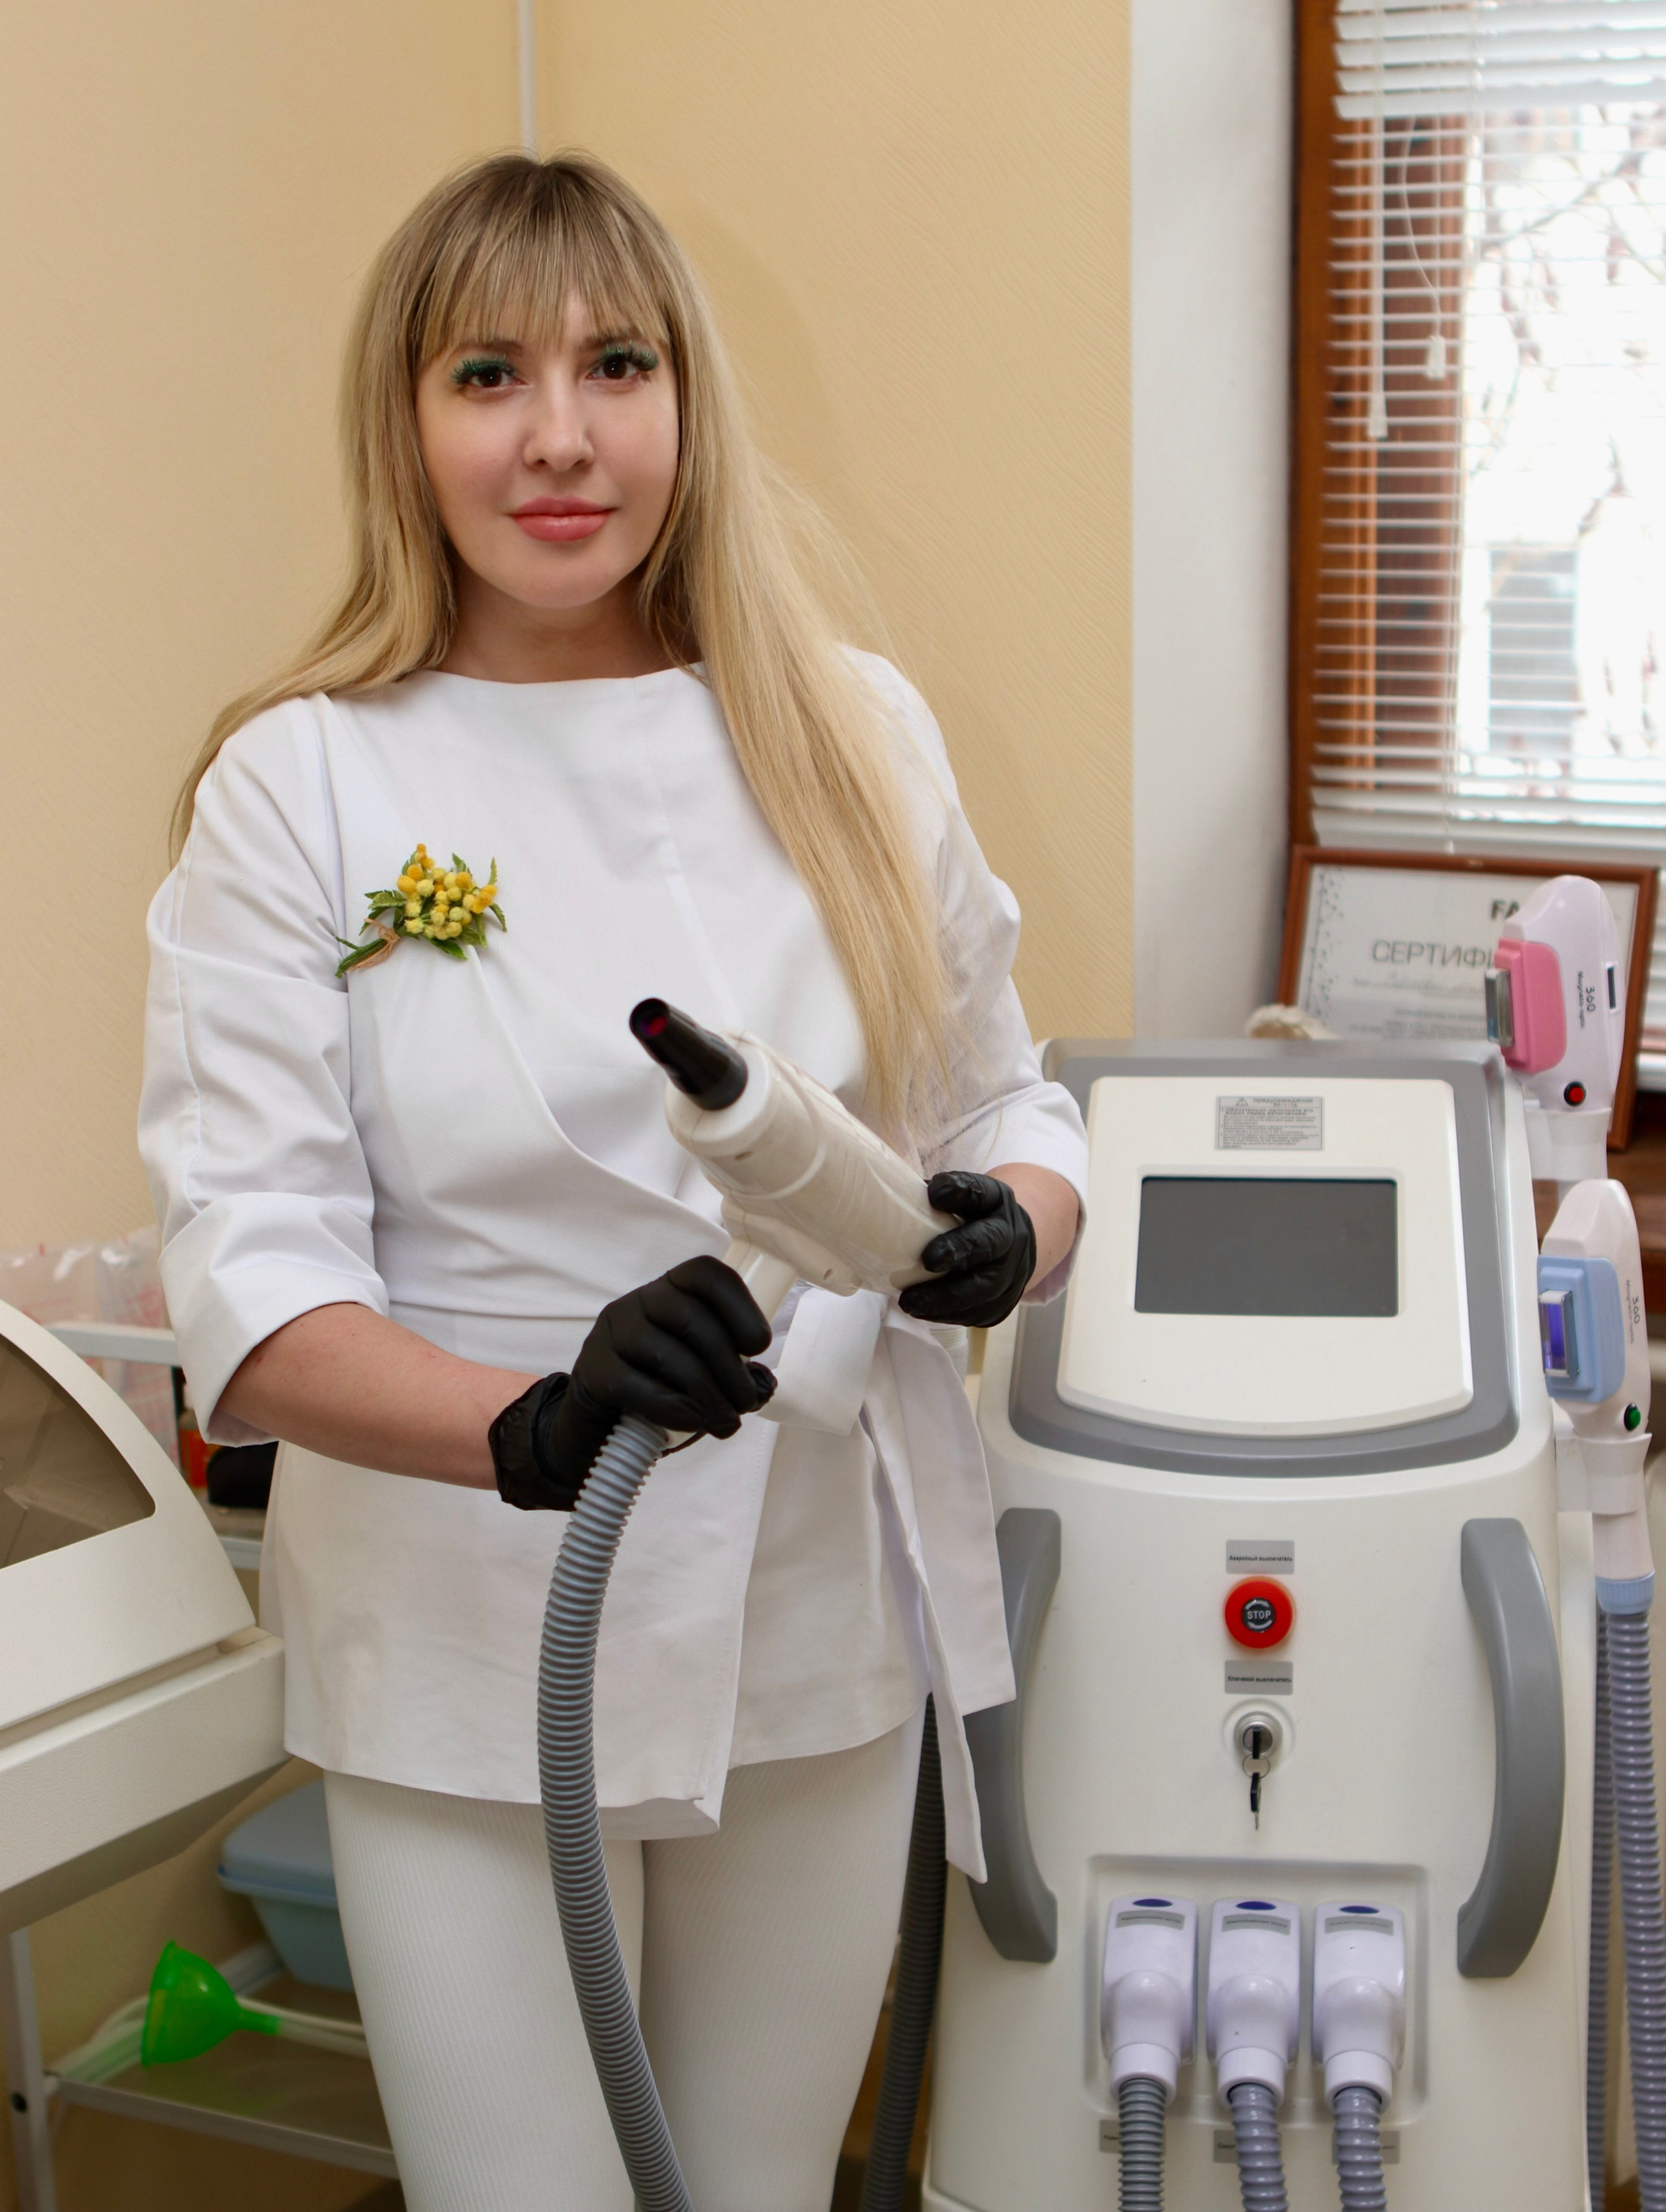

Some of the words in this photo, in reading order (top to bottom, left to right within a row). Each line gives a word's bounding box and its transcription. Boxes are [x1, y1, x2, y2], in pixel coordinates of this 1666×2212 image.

[1586, 986, 1596, 1012] 360
[1632, 1295, 1641, 1324] 360
[1248, 1610, 1271, 1620] STOP
